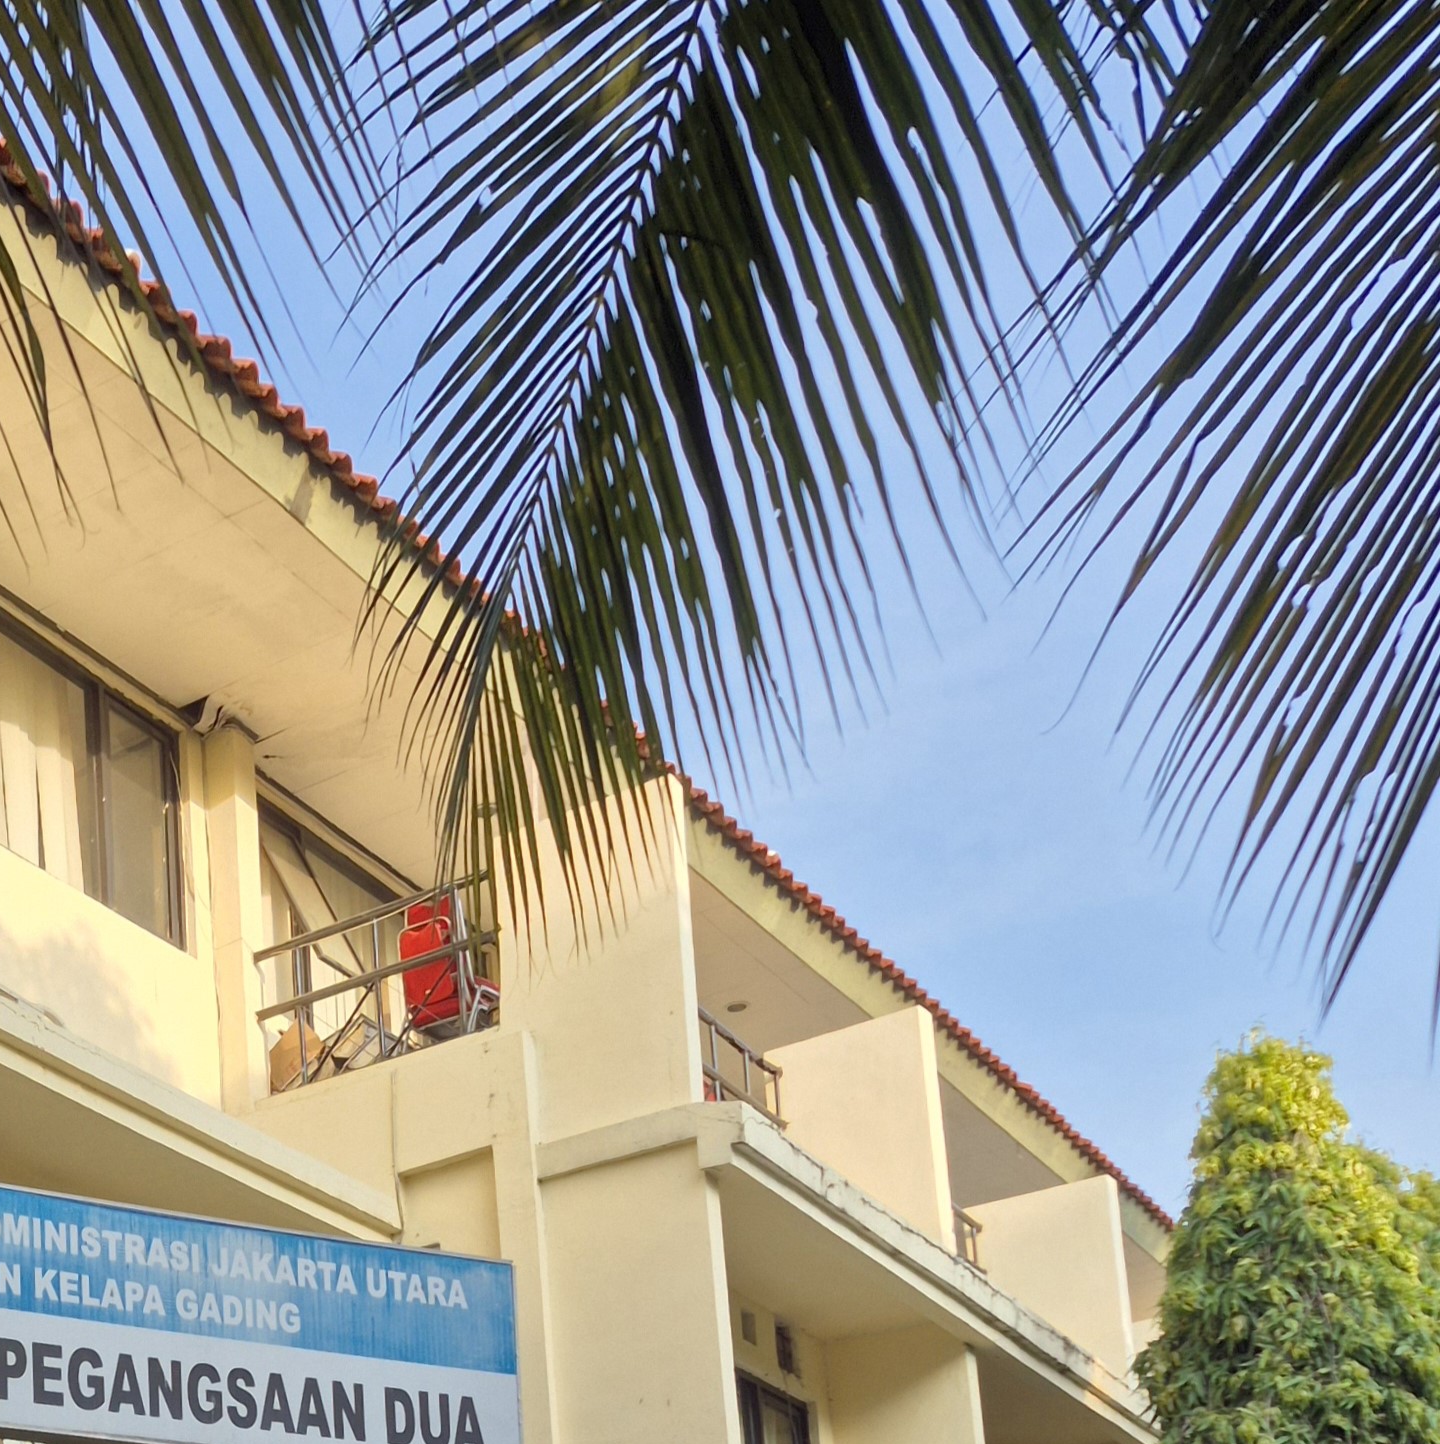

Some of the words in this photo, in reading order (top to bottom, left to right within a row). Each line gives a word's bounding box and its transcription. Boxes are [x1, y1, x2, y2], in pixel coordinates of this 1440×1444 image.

[34, 1267, 166, 1316] KELAPA
[175, 1288, 301, 1334] GADING
[211, 1246, 358, 1295] JAKARTA
[365, 1267, 469, 1310] UTARA
